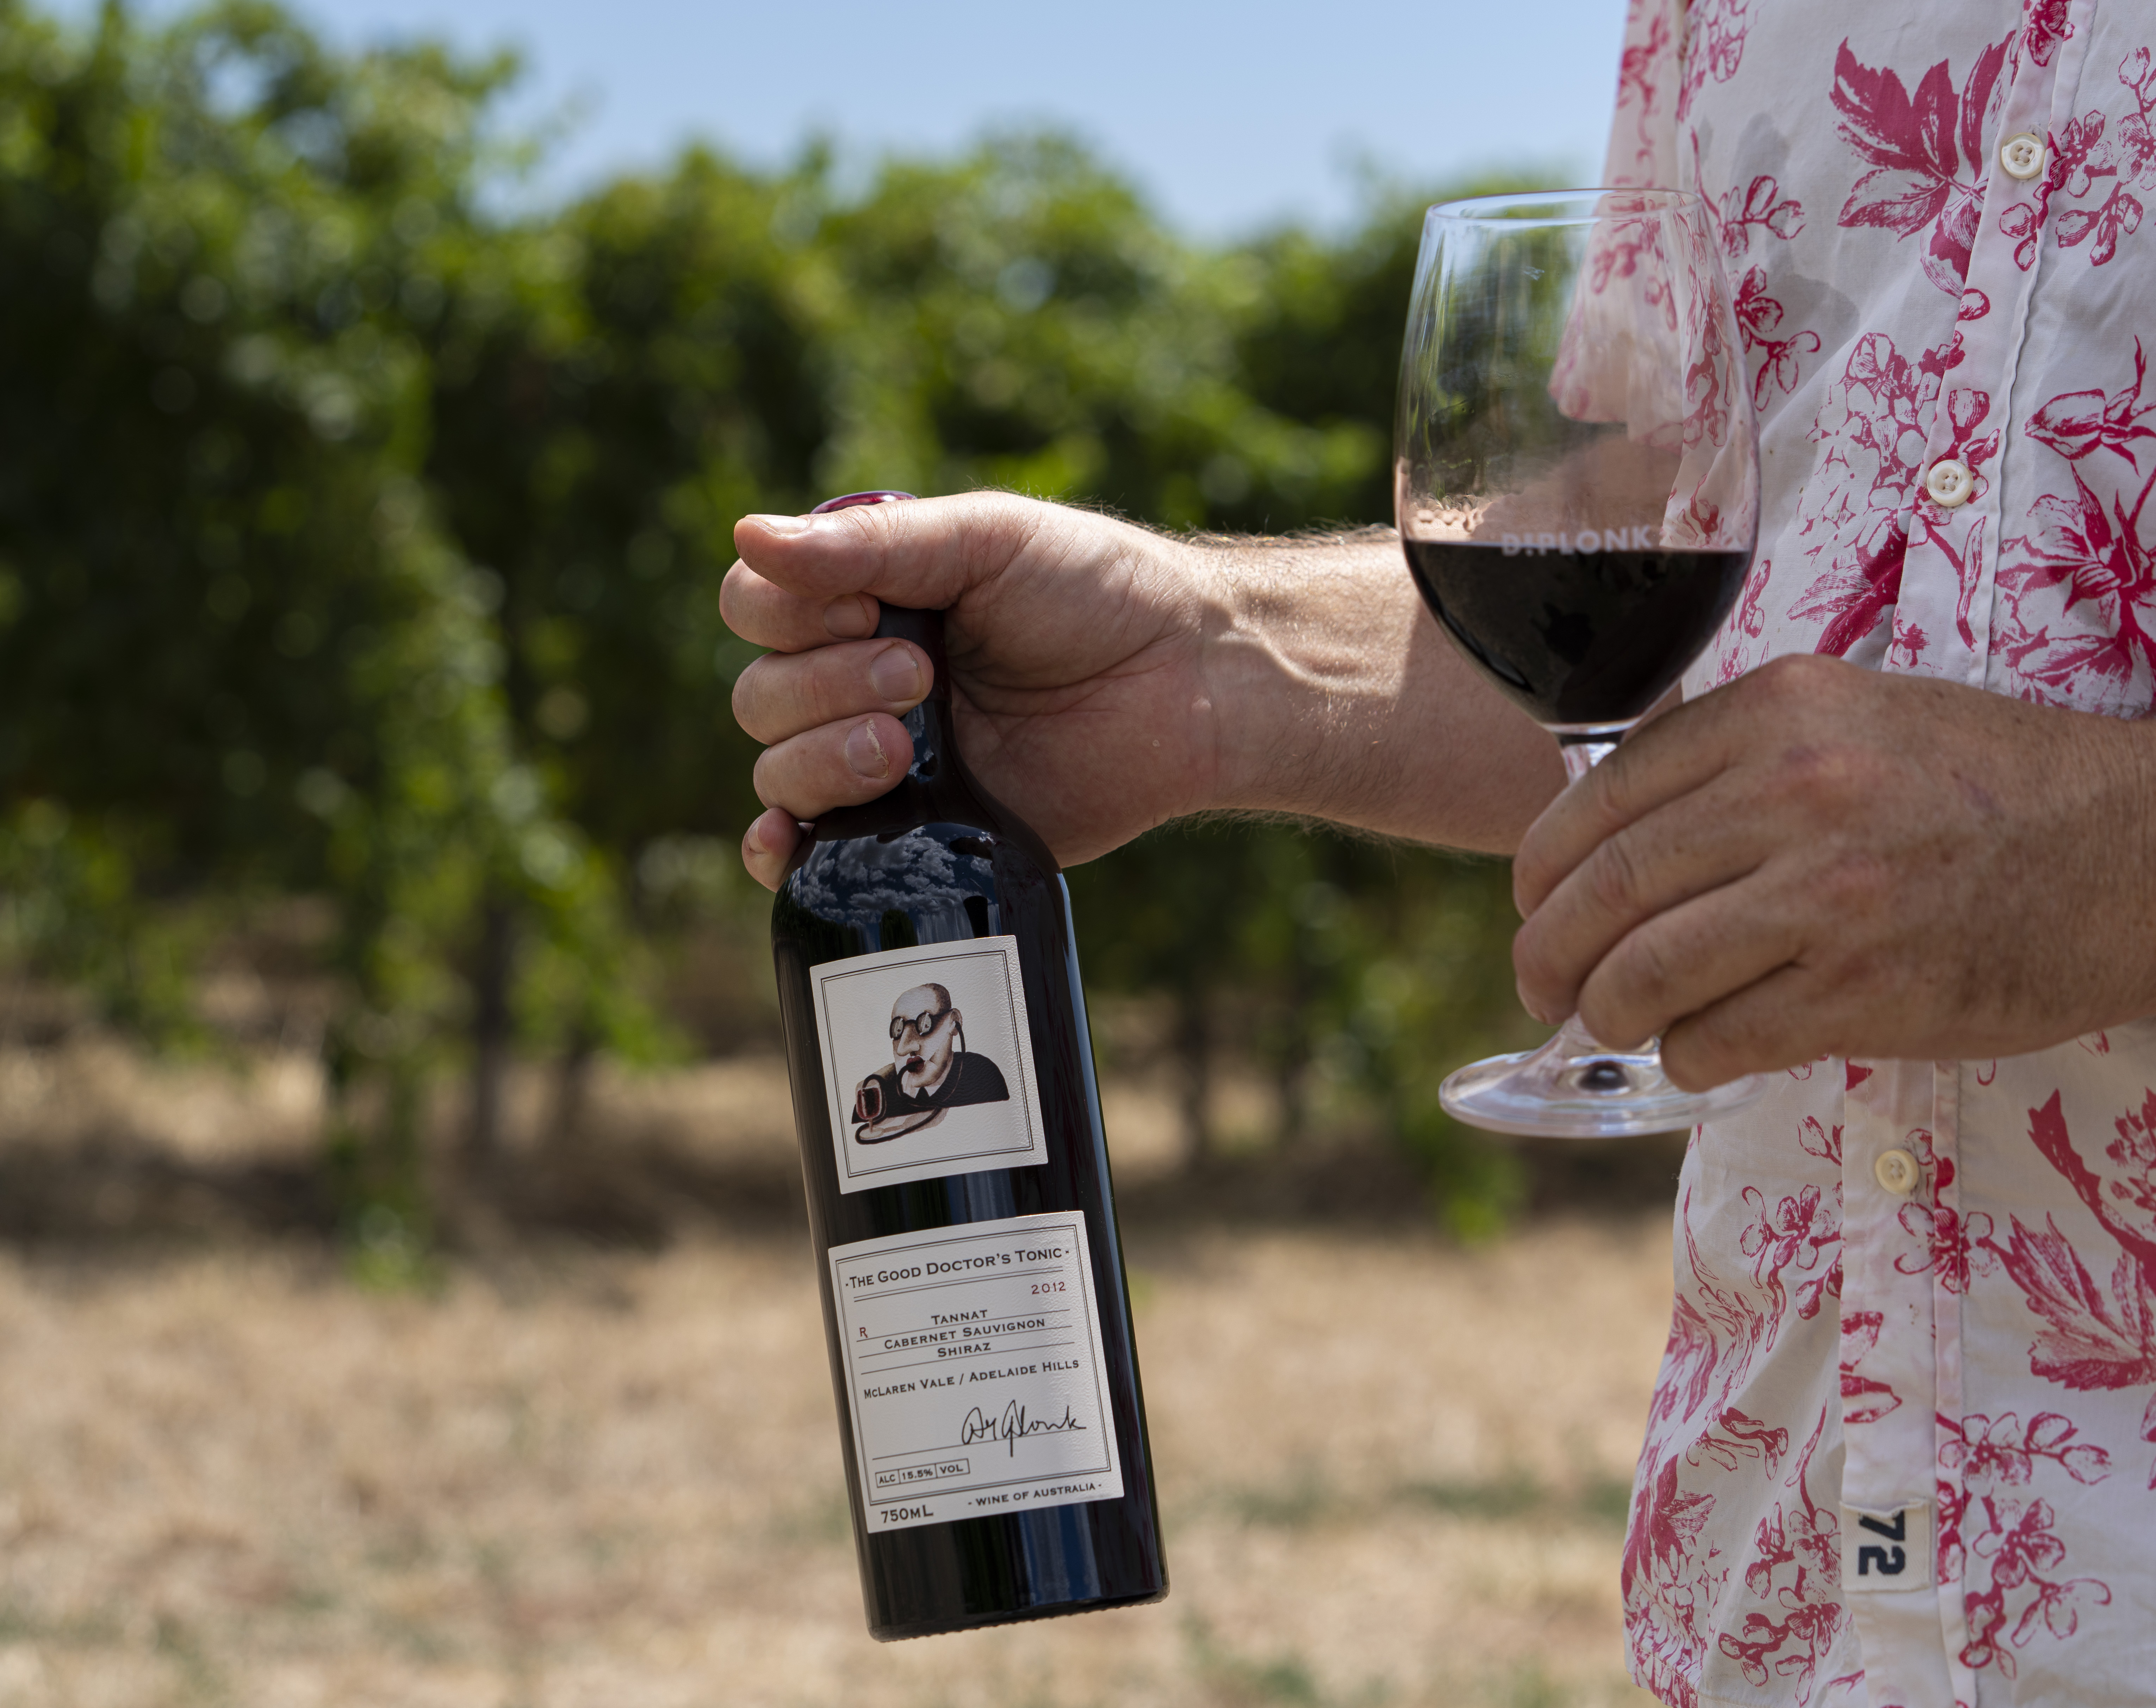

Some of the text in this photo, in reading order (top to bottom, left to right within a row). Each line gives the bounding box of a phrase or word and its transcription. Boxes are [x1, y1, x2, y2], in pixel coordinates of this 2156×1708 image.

[849, 1275, 874, 1289] THE
[878, 1267, 921, 1282] GOOD
[1015, 1248, 1062, 1262] TONIC
[1031, 1282, 1065, 1295] 2012
[931, 1309, 988, 1326] TANNAT
[885, 1319, 1045, 1349] CABERNET SAUVIGNON
[938, 1342, 992, 1357] SHIRAZ
[920, 1377, 954, 1389] VALE
[970, 1365, 1037, 1382] ADELAIDE
[1042, 1360, 1079, 1372] HILLS
[880, 1464, 964, 1483] ALC 15.5% VOL
[976, 1483, 1095, 1506] WINE OF AUSTRALIA
